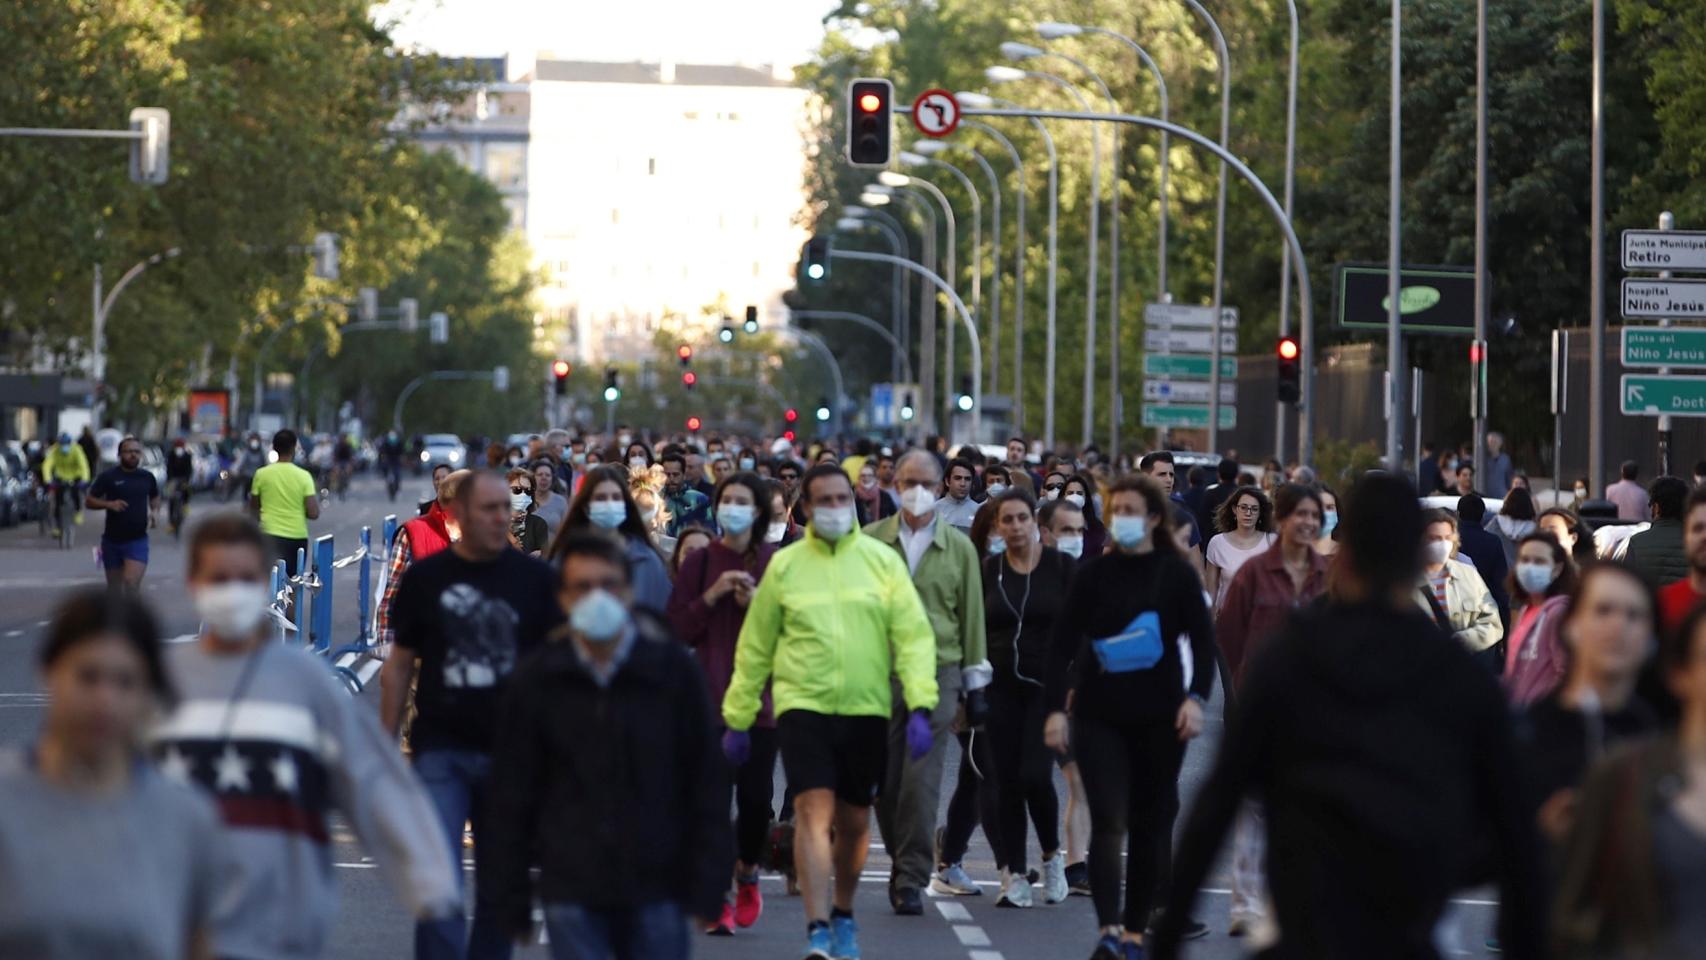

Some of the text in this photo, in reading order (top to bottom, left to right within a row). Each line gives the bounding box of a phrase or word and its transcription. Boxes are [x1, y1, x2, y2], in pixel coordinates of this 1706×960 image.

[1630, 240, 1706, 250] Junta Municipal
[1629, 251, 1671, 263] Retiro
[1628, 287, 1669, 296] hospital
[1659, 334, 1675, 344] del
[1672, 395, 1706, 409] Doct
